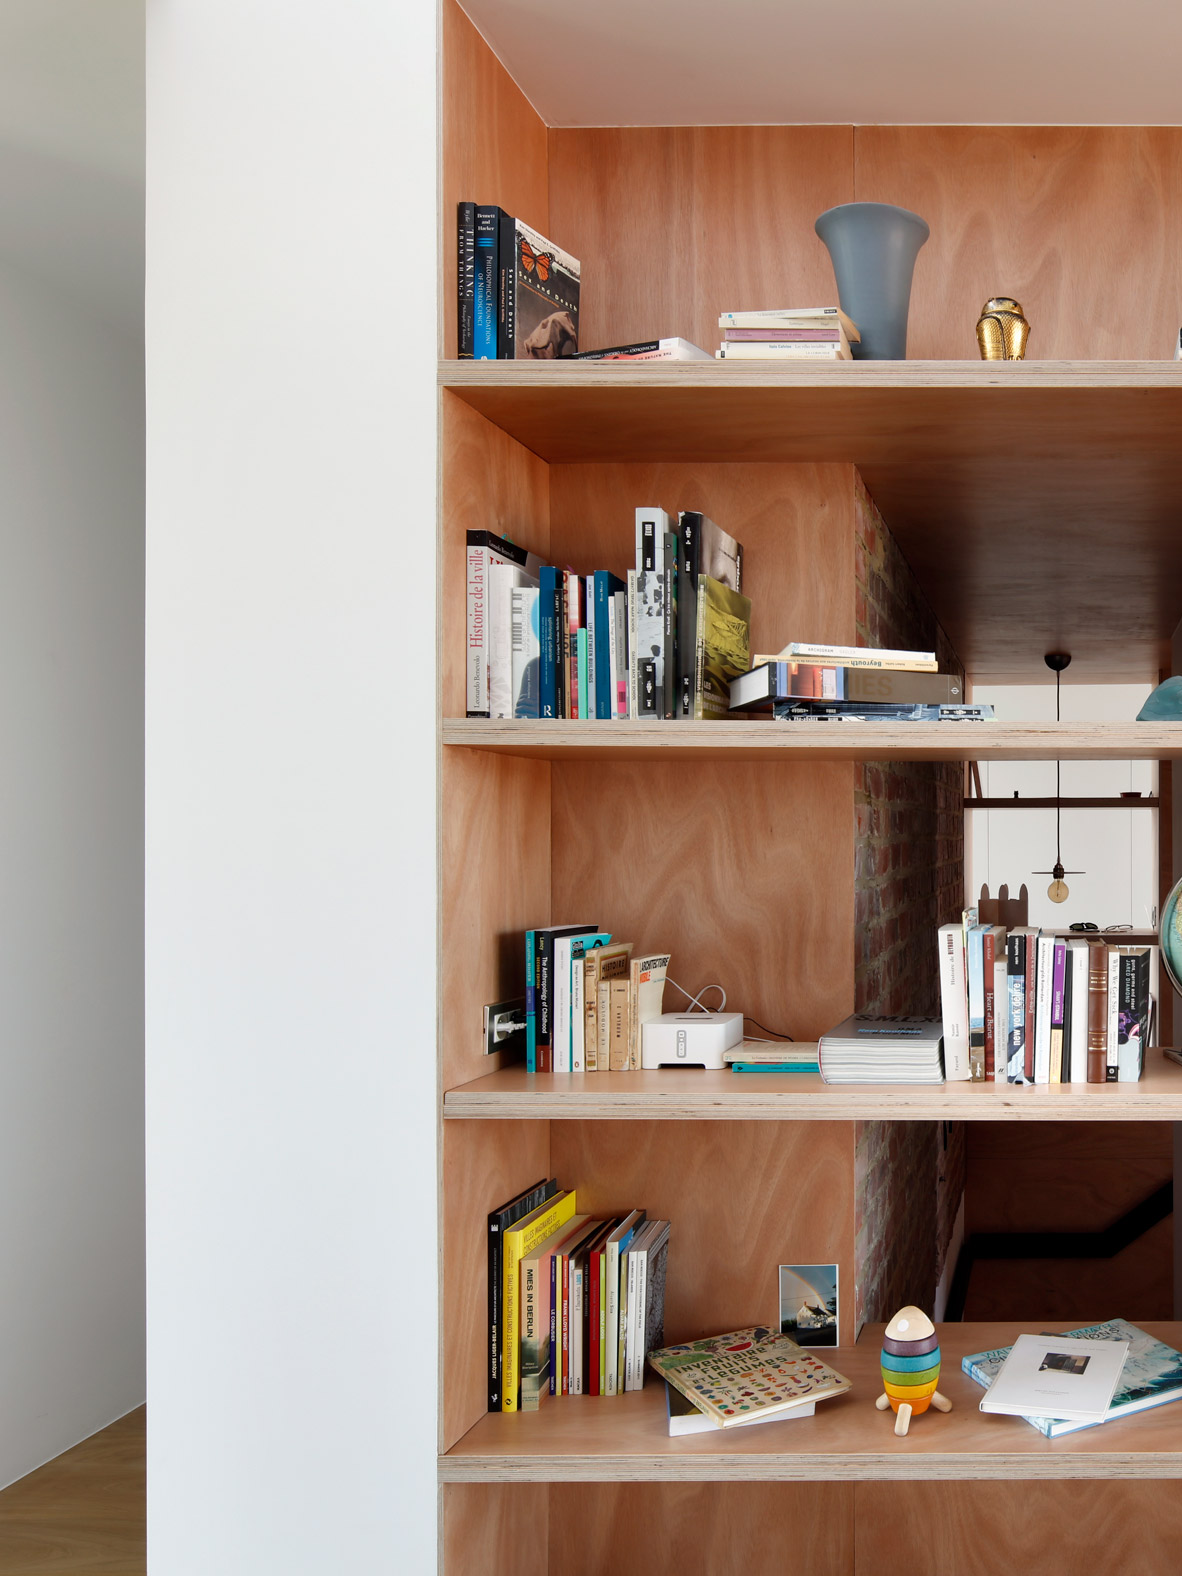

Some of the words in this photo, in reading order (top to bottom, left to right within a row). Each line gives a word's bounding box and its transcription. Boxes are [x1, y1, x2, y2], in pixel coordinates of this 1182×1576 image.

[466, 229, 474, 297] THINKING
[536, 283, 551, 296] and
[555, 293, 578, 313] Death
[469, 549, 484, 572] ville
[469, 575, 483, 584] la
[469, 586, 483, 599] de
[469, 603, 483, 648] Histoire
[602, 959, 625, 972] HISTOIRE
[1112, 975, 1118, 986] We
[986, 993, 994, 1011] Heart
[1012, 1009, 1024, 1027] york
[1012, 1029, 1021, 1046] new
[700, 1356, 761, 1374] FRUITS
